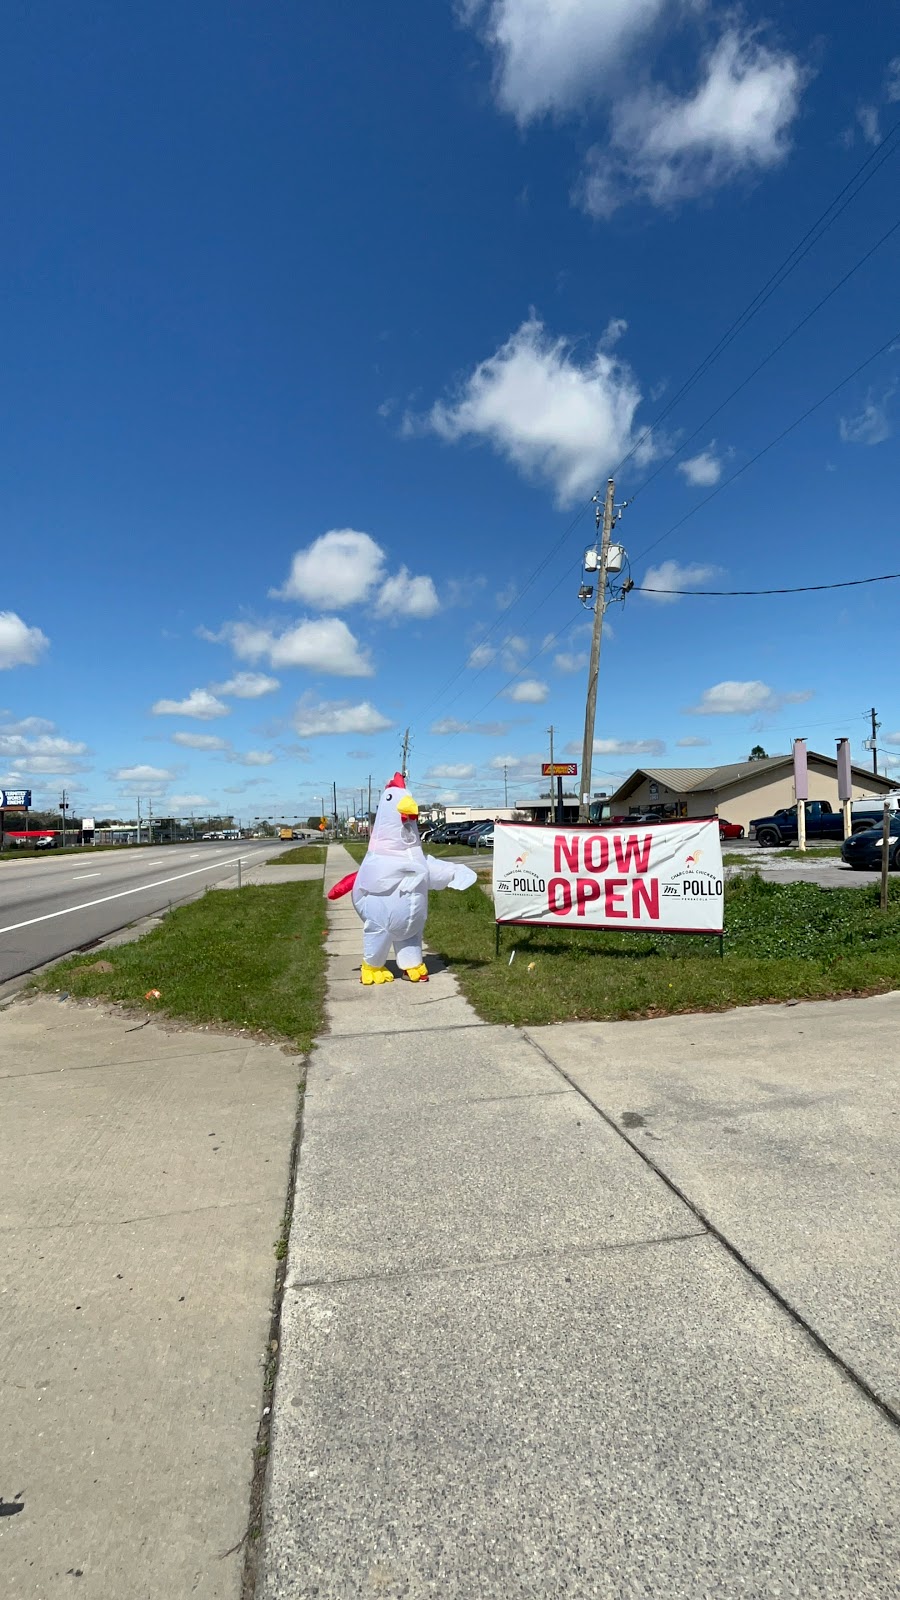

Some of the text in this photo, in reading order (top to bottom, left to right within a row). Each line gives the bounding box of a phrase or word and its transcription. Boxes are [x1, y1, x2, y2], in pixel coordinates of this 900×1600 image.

[554, 834, 652, 873] NOW
[671, 870, 716, 880] CHARCOAL CHICKEN
[513, 878, 545, 892] POLLO
[683, 880, 722, 896] POLLO
[548, 878, 659, 919] OPEN
